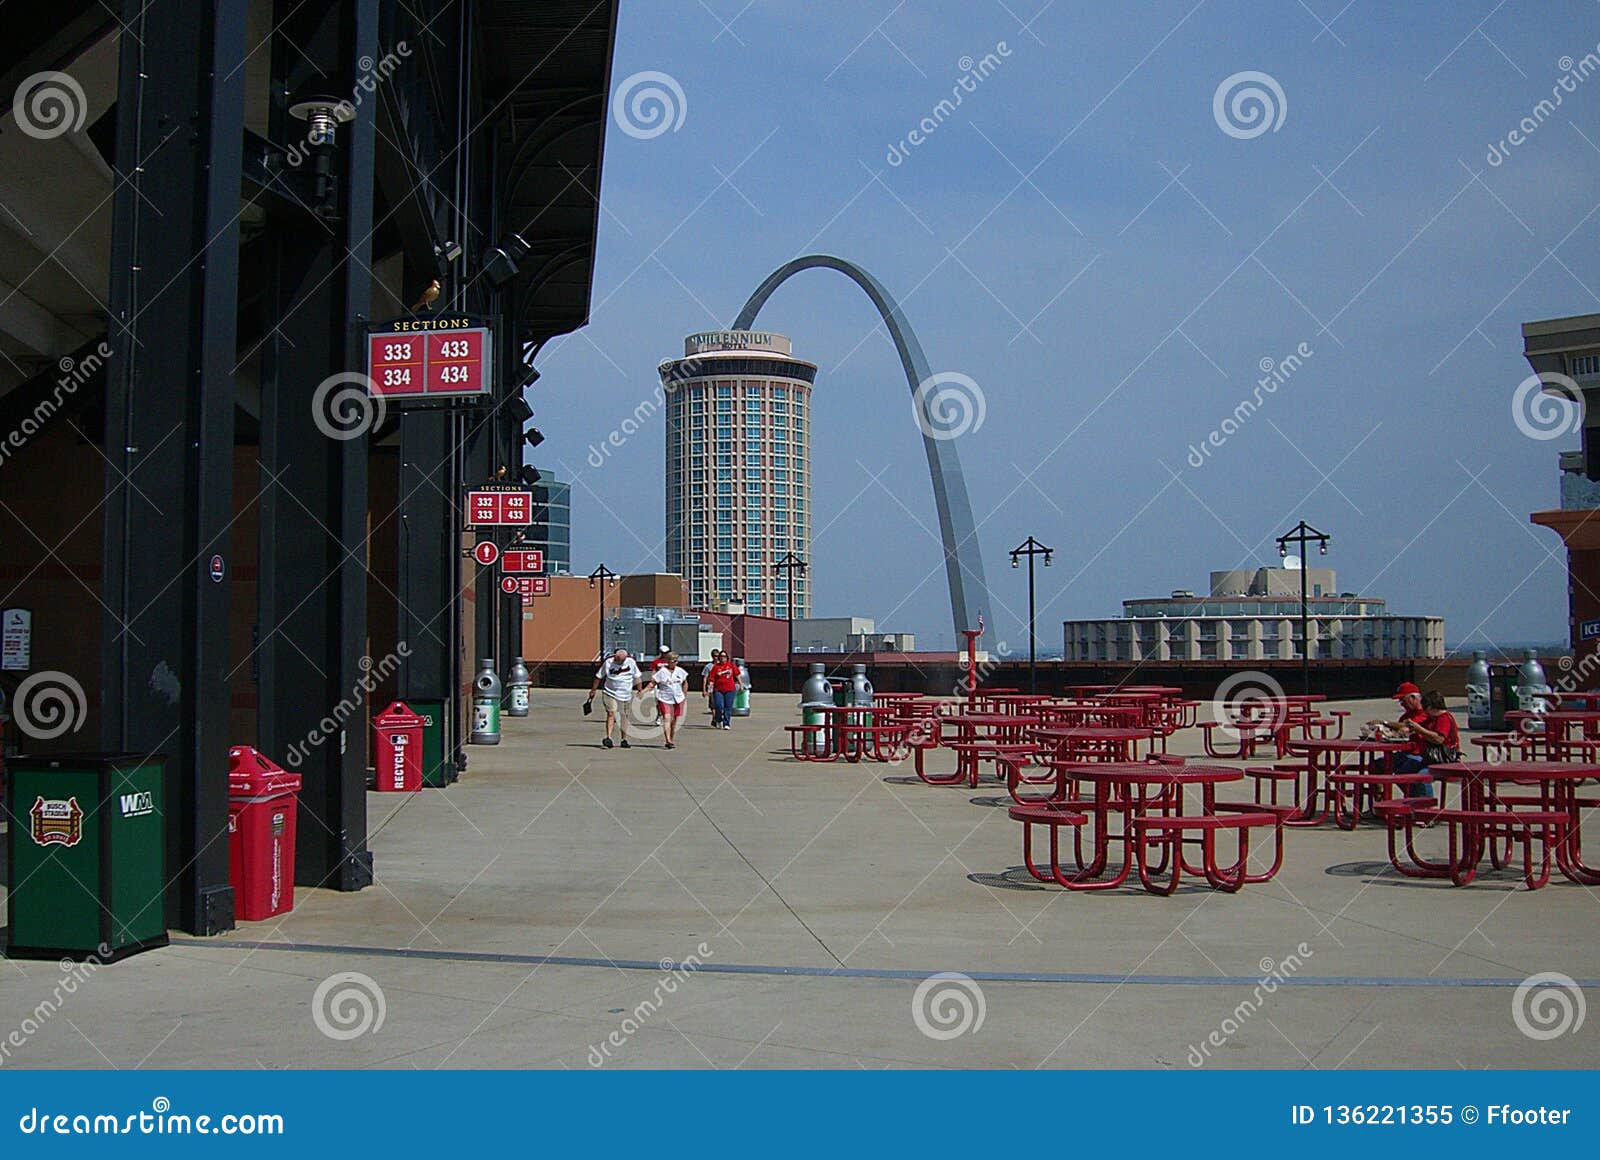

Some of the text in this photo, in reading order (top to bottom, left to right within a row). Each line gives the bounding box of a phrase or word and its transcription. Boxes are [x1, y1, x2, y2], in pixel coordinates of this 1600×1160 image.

[394, 319, 469, 331] SECTIONS
[692, 333, 772, 346] MILLENNIUM
[384, 344, 411, 361] 333
[441, 341, 468, 357] 433
[384, 369, 411, 386] 334
[441, 366, 468, 383] 434
[477, 498, 493, 506] 332
[508, 498, 523, 506] 432
[477, 510, 493, 519] 333
[508, 510, 523, 519] 433
[394, 745, 404, 788] RECYCLE
[120, 791, 153, 813] WM
